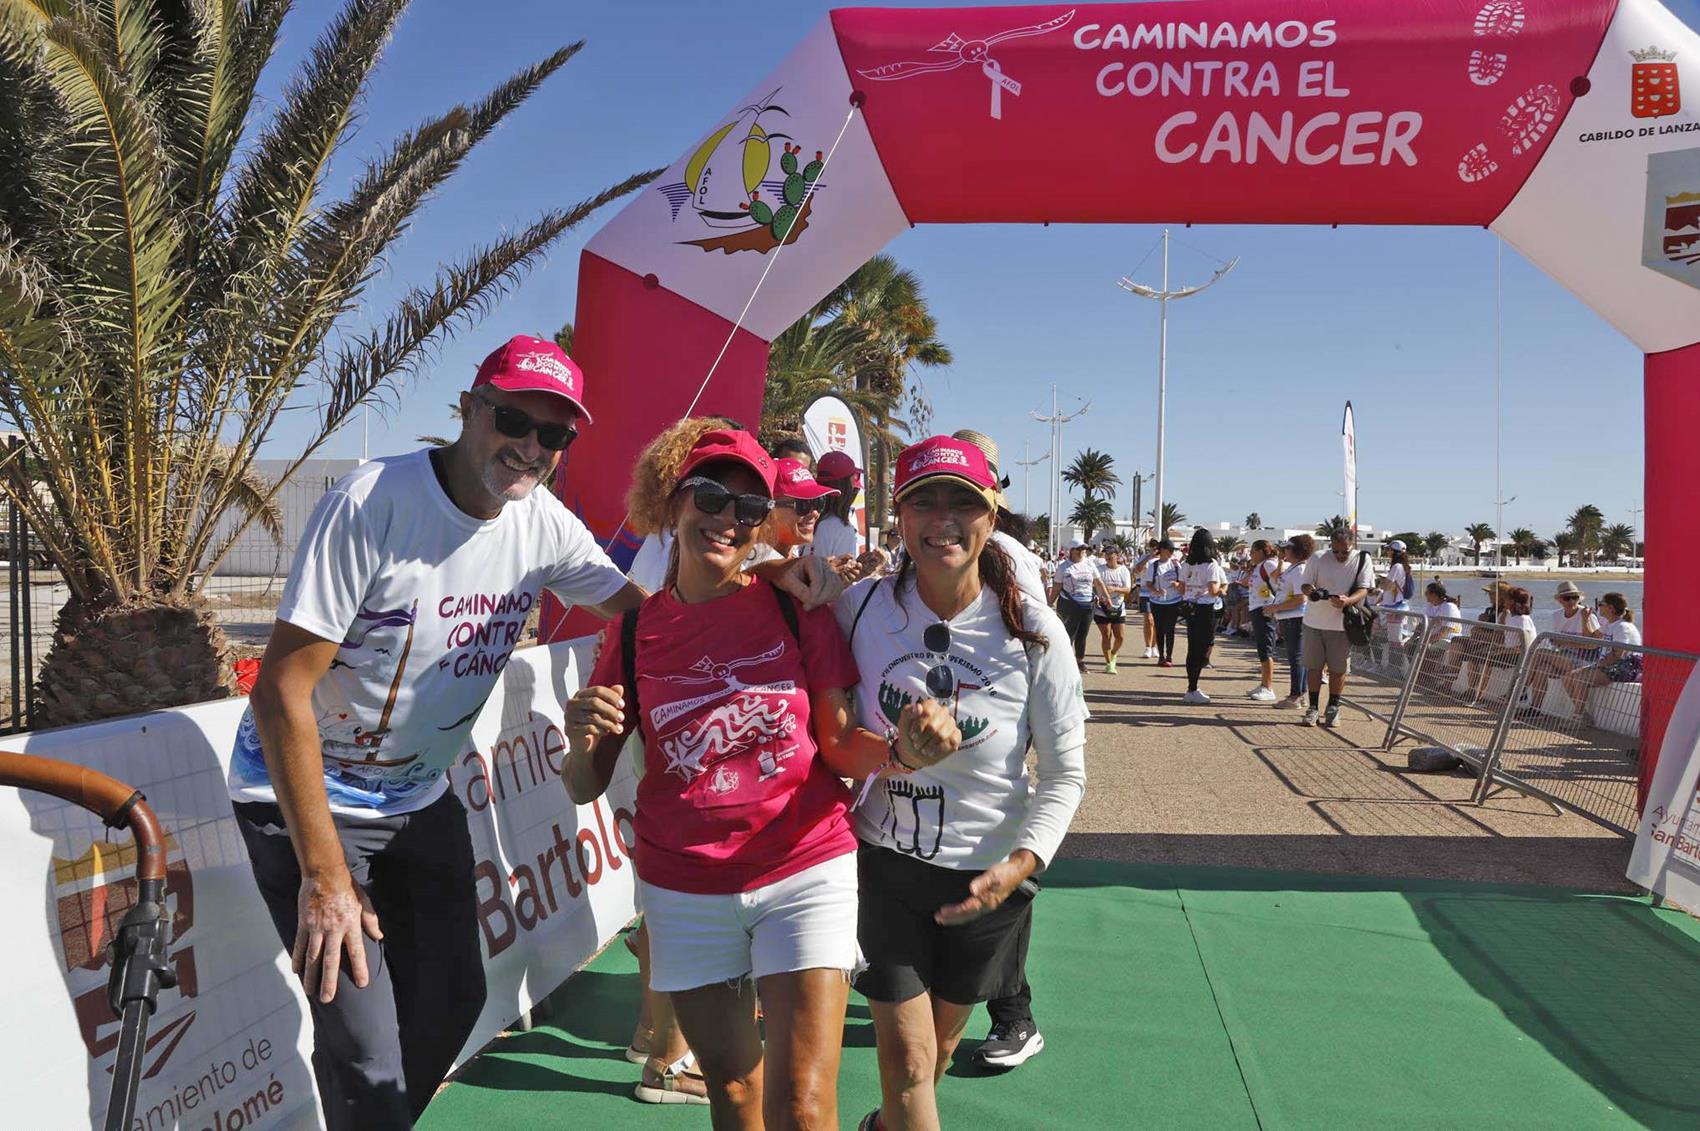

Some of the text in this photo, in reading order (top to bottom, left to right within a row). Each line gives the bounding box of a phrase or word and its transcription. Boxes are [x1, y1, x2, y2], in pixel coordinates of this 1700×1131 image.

[1073, 20, 1337, 50] CAMINAMOS
[1096, 61, 1350, 97] CONTRA EL
[1154, 110, 1423, 167] CANCER
[1579, 122, 1700, 142] CABILDO DE LANZA
[699, 167, 711, 205] AFOL
[980, 674, 998, 697] 2016
[653, 697, 705, 724] CAMINAMOS
[242, 1038, 272, 1070] de
[201, 1073, 284, 1131] lomé
